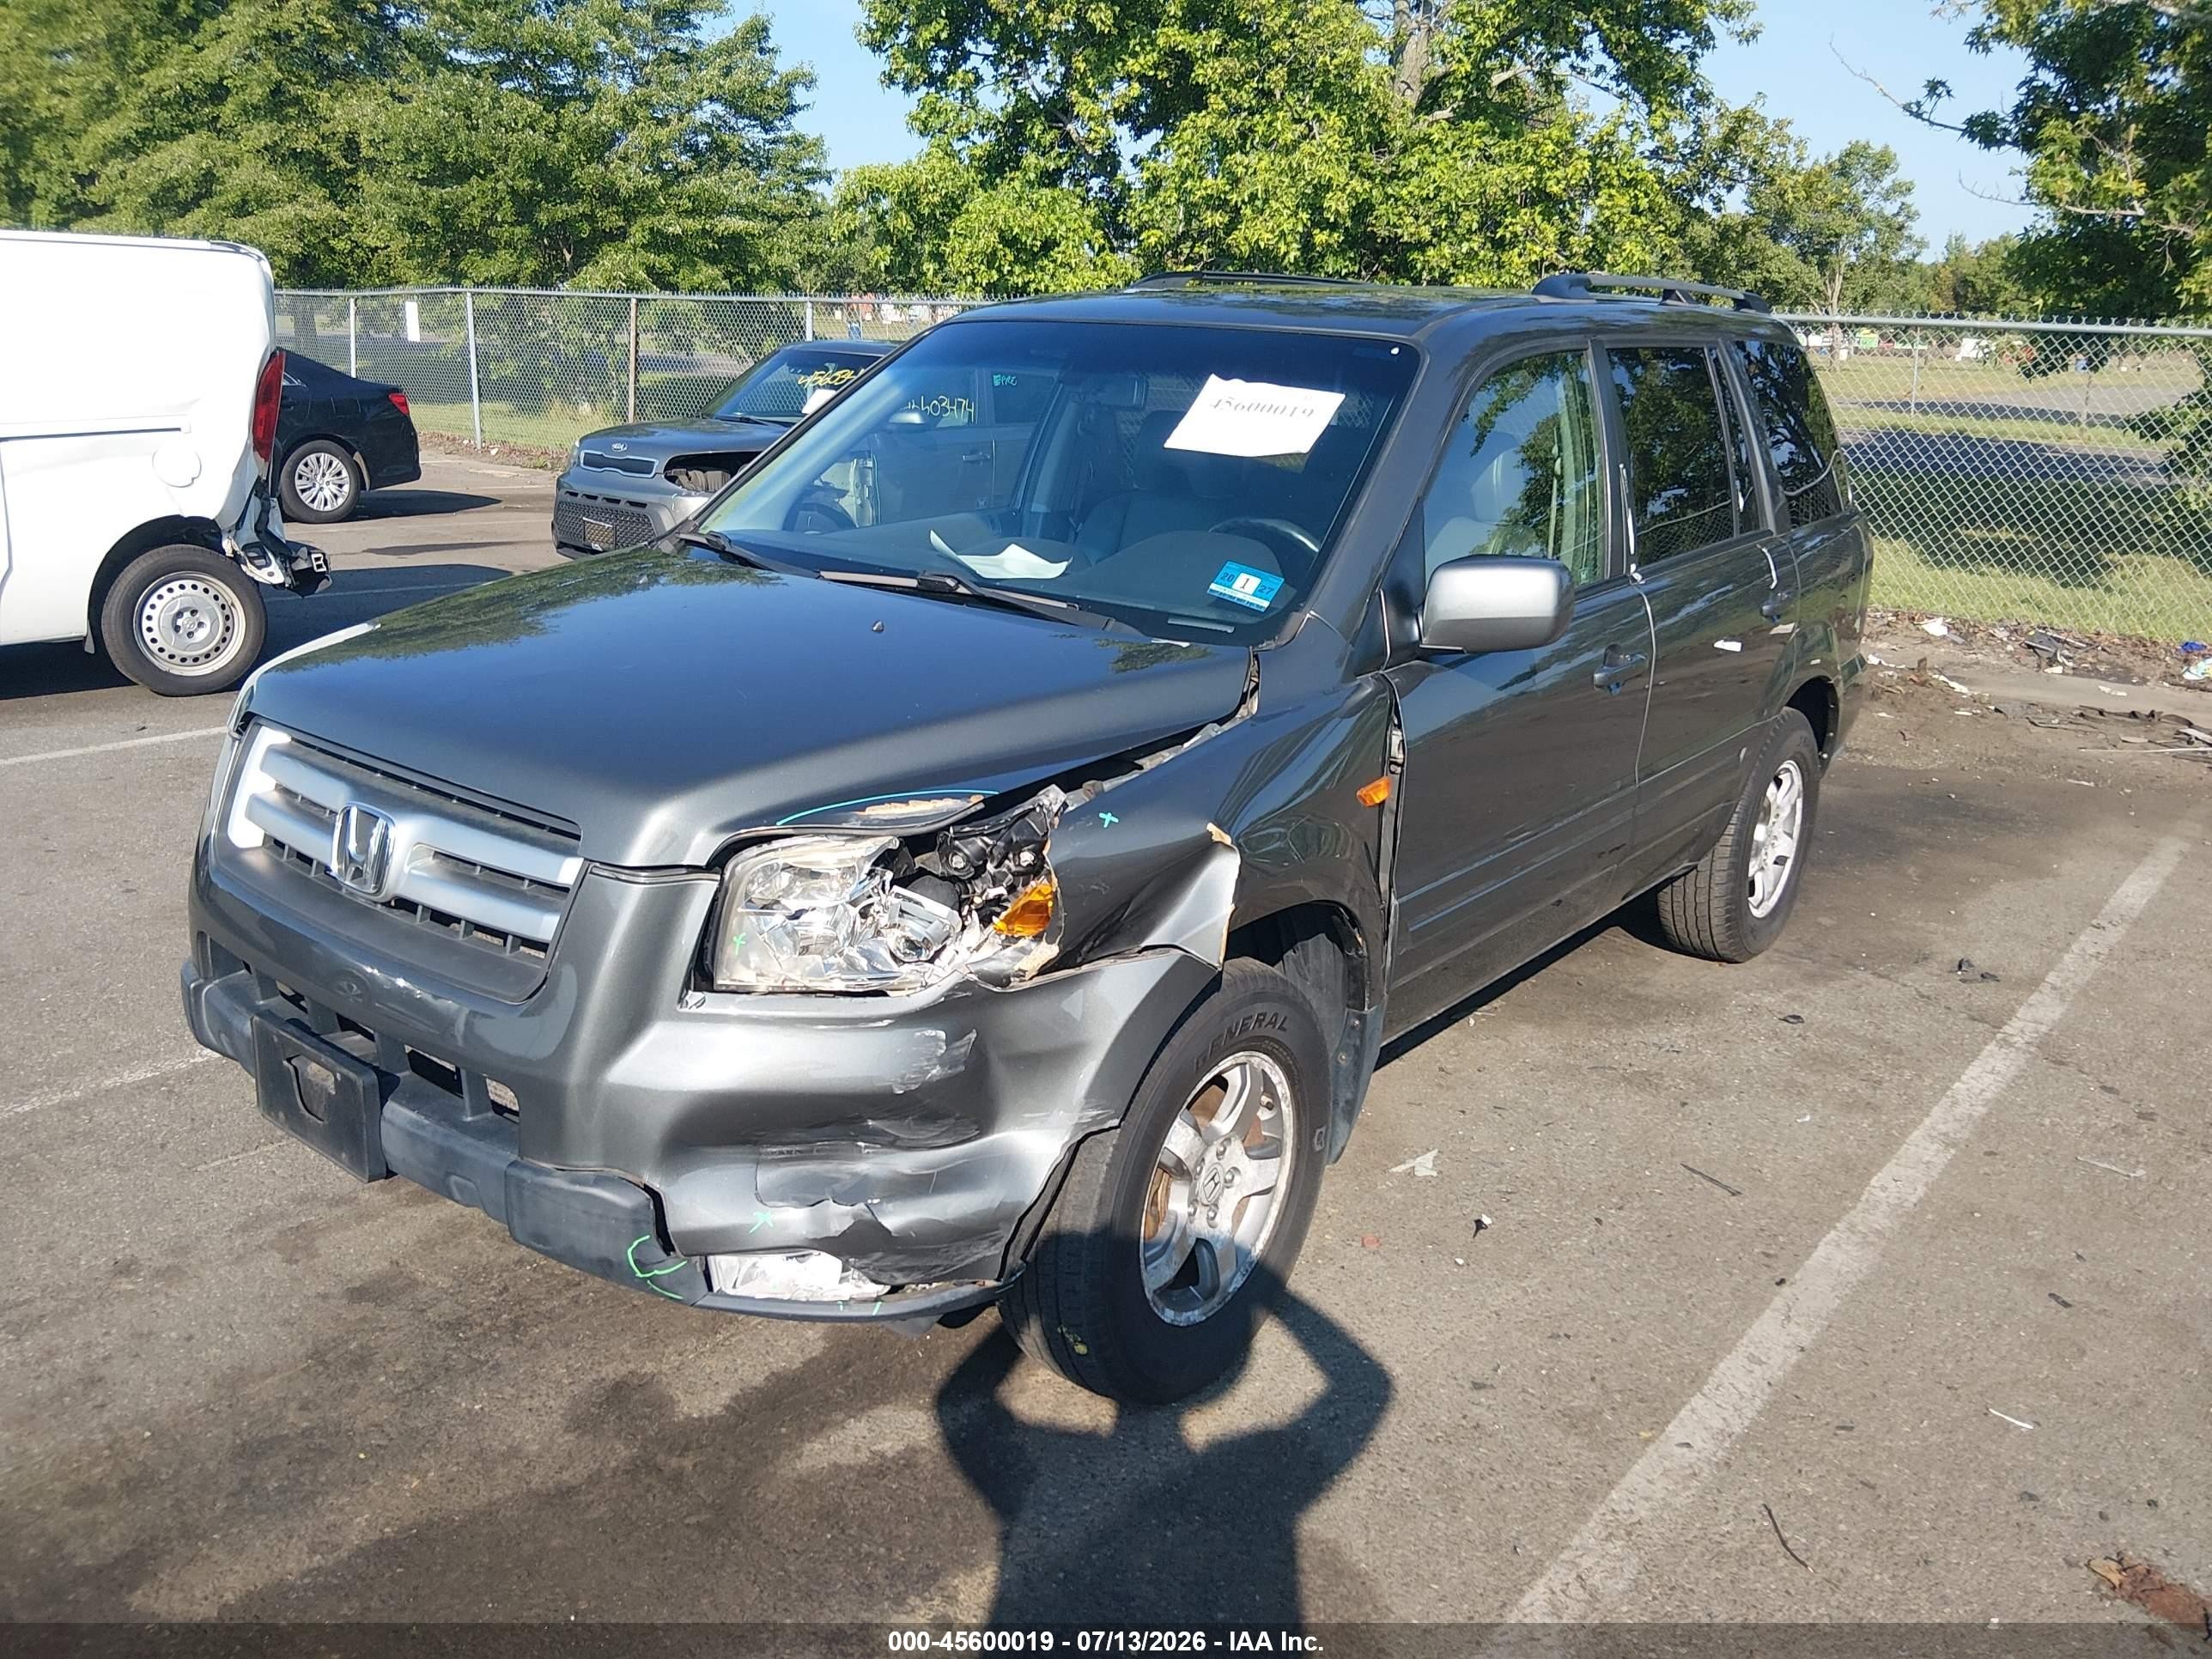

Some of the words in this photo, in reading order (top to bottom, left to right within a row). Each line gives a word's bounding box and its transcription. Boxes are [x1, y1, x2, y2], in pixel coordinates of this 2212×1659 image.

[1219, 571, 1236, 583] 20
[1239, 577, 1250, 590] 1
[1257, 585, 1274, 595] 27
